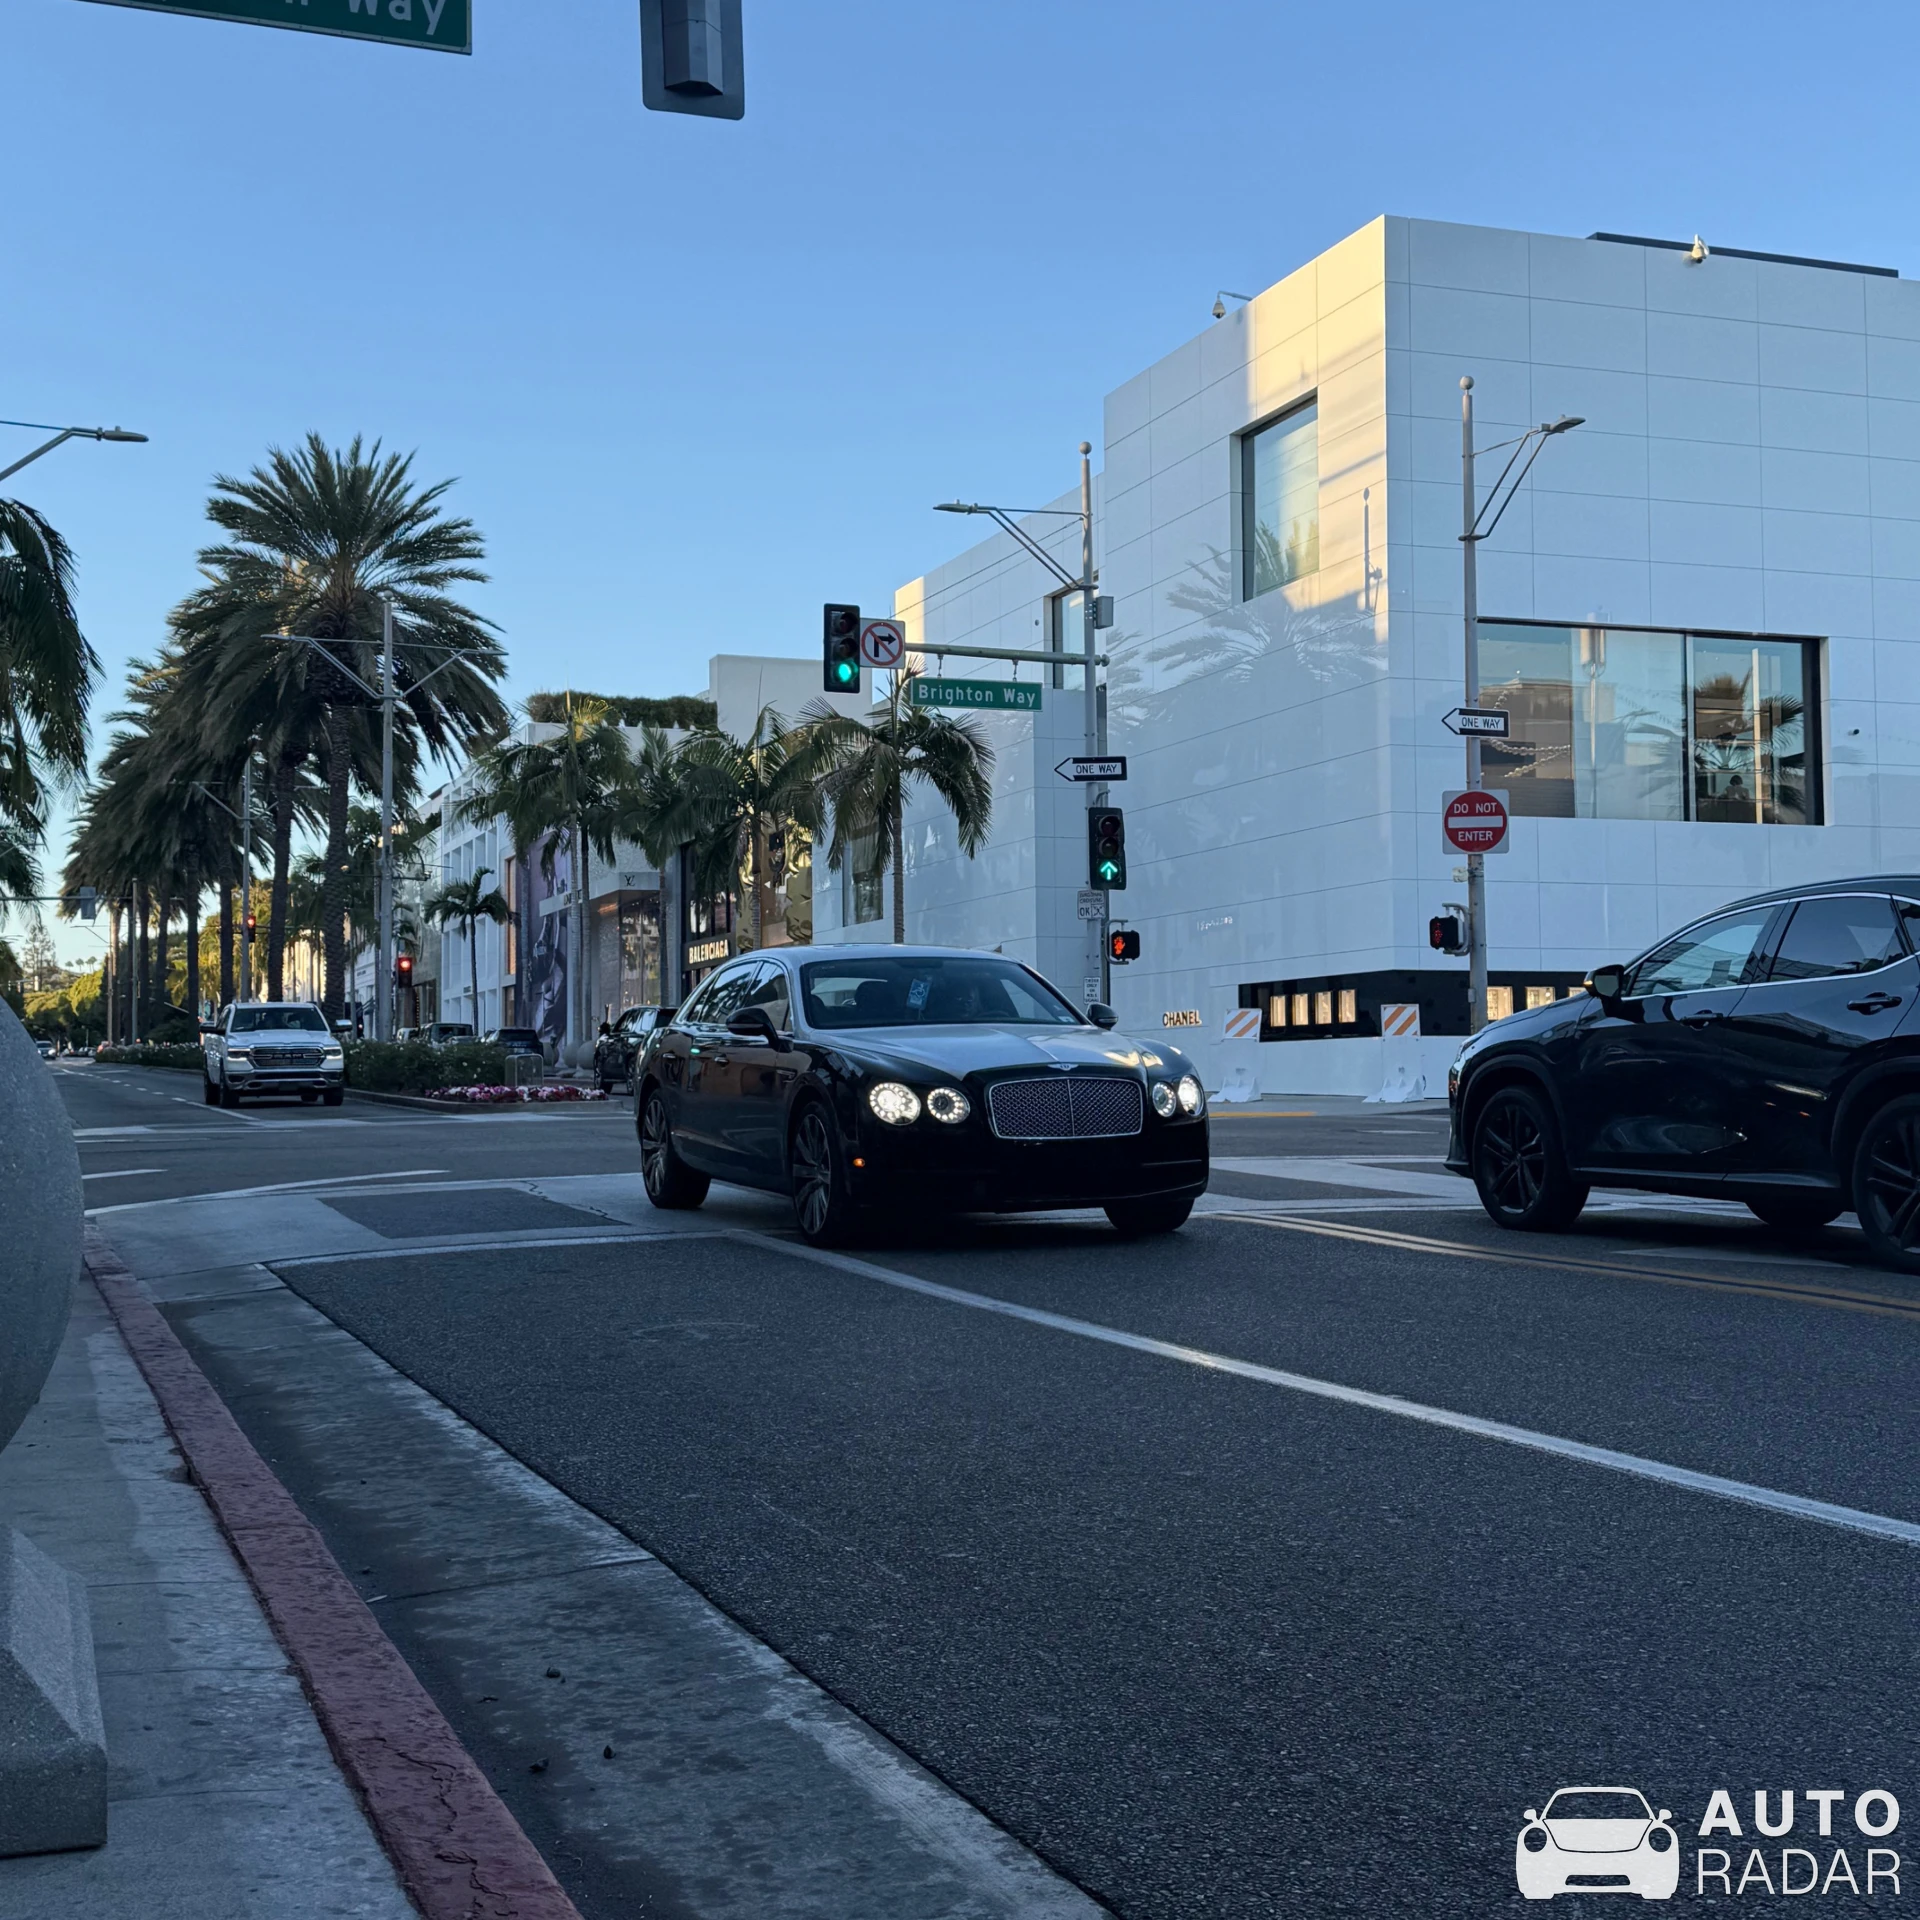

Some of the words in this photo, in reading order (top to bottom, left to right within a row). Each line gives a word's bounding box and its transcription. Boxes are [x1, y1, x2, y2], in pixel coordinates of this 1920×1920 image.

[918, 684, 993, 705] Brighton
[1003, 688, 1036, 707] Way
[1461, 716, 1479, 728] ONE
[1483, 718, 1501, 729] WAY
[1075, 764, 1094, 774] ONE
[1098, 764, 1118, 774] WAY
[1453, 802, 1469, 814] DO
[1475, 802, 1497, 814] NOT
[1457, 830, 1493, 842] ENTER
[1079, 906, 1090, 917] OK
[688, 939, 729, 965] BALENCIAGA
[1162, 1009, 1203, 1029] CHANEL
